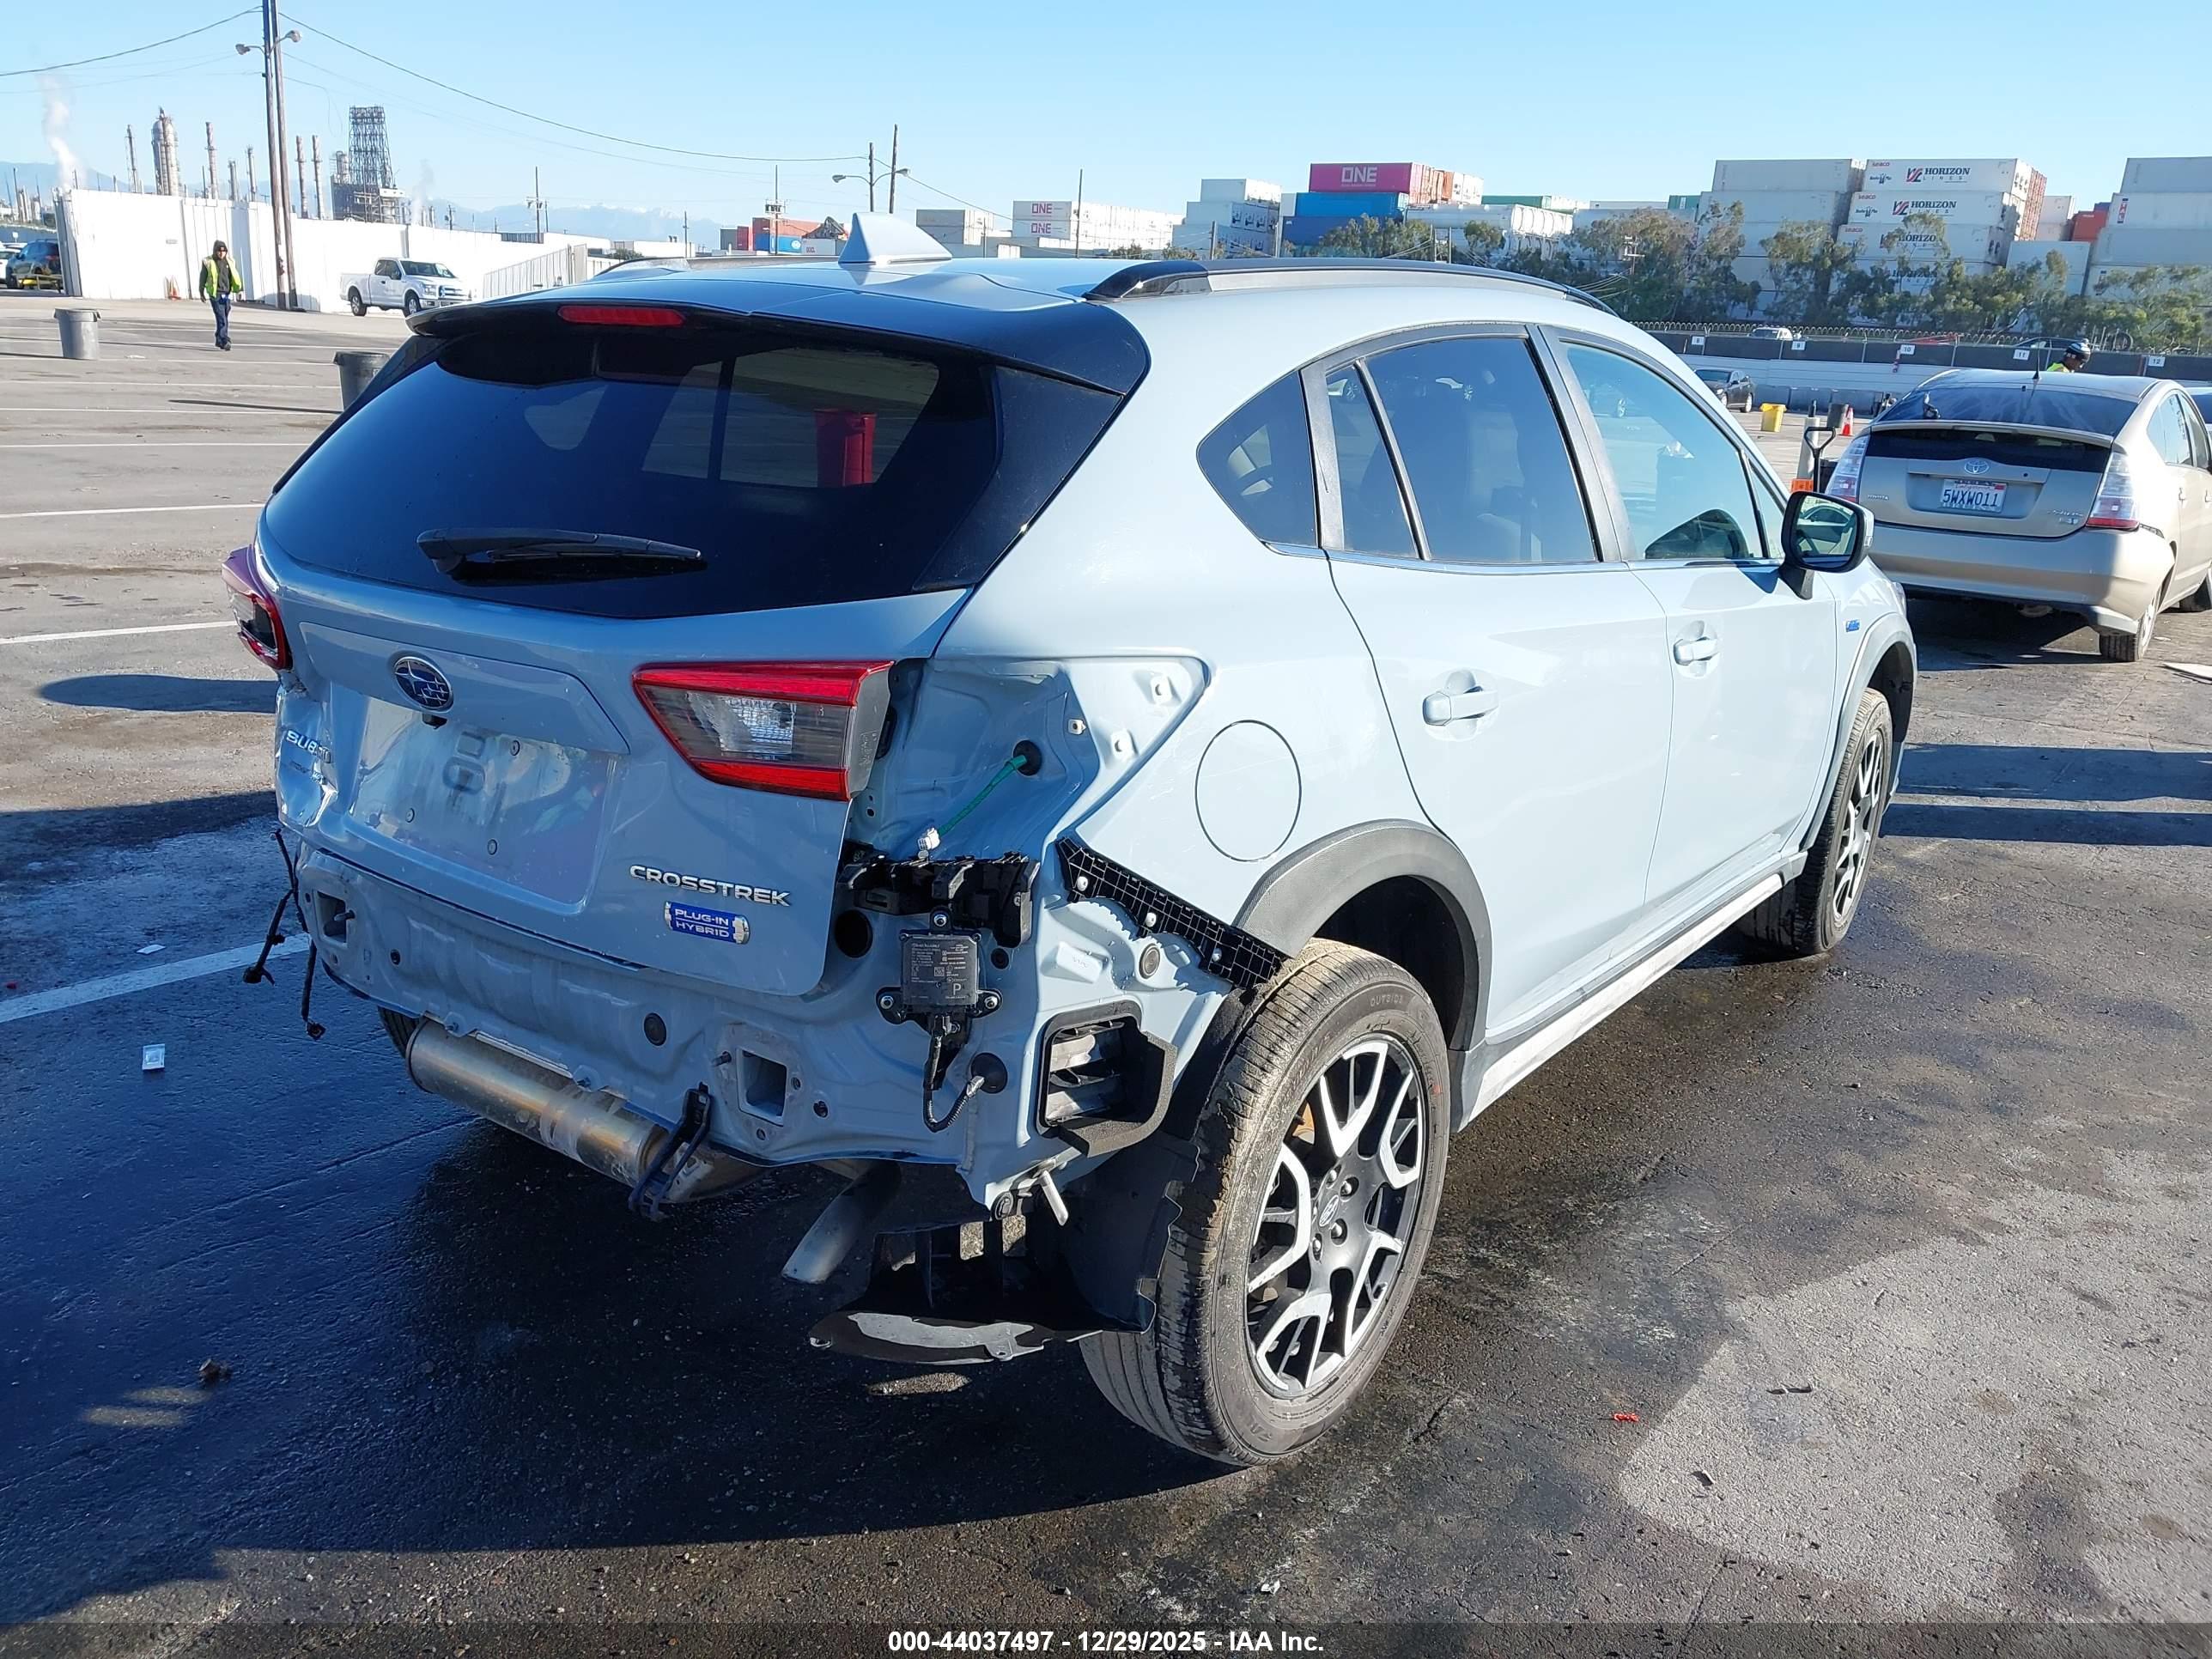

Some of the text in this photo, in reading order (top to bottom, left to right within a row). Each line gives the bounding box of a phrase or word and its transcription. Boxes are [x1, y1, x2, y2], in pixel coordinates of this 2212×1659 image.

[1341, 167, 1377, 183] ONE
[1032, 204, 1053, 214] ONE
[1030, 223, 1051, 234] ONE
[1942, 489, 1999, 507] 5WXW011
[629, 865, 791, 907] CROSSTREK
[675, 908, 729, 927] PLUG-IN
[676, 921, 730, 939] HYBRID
[953, 983, 962, 995] P
